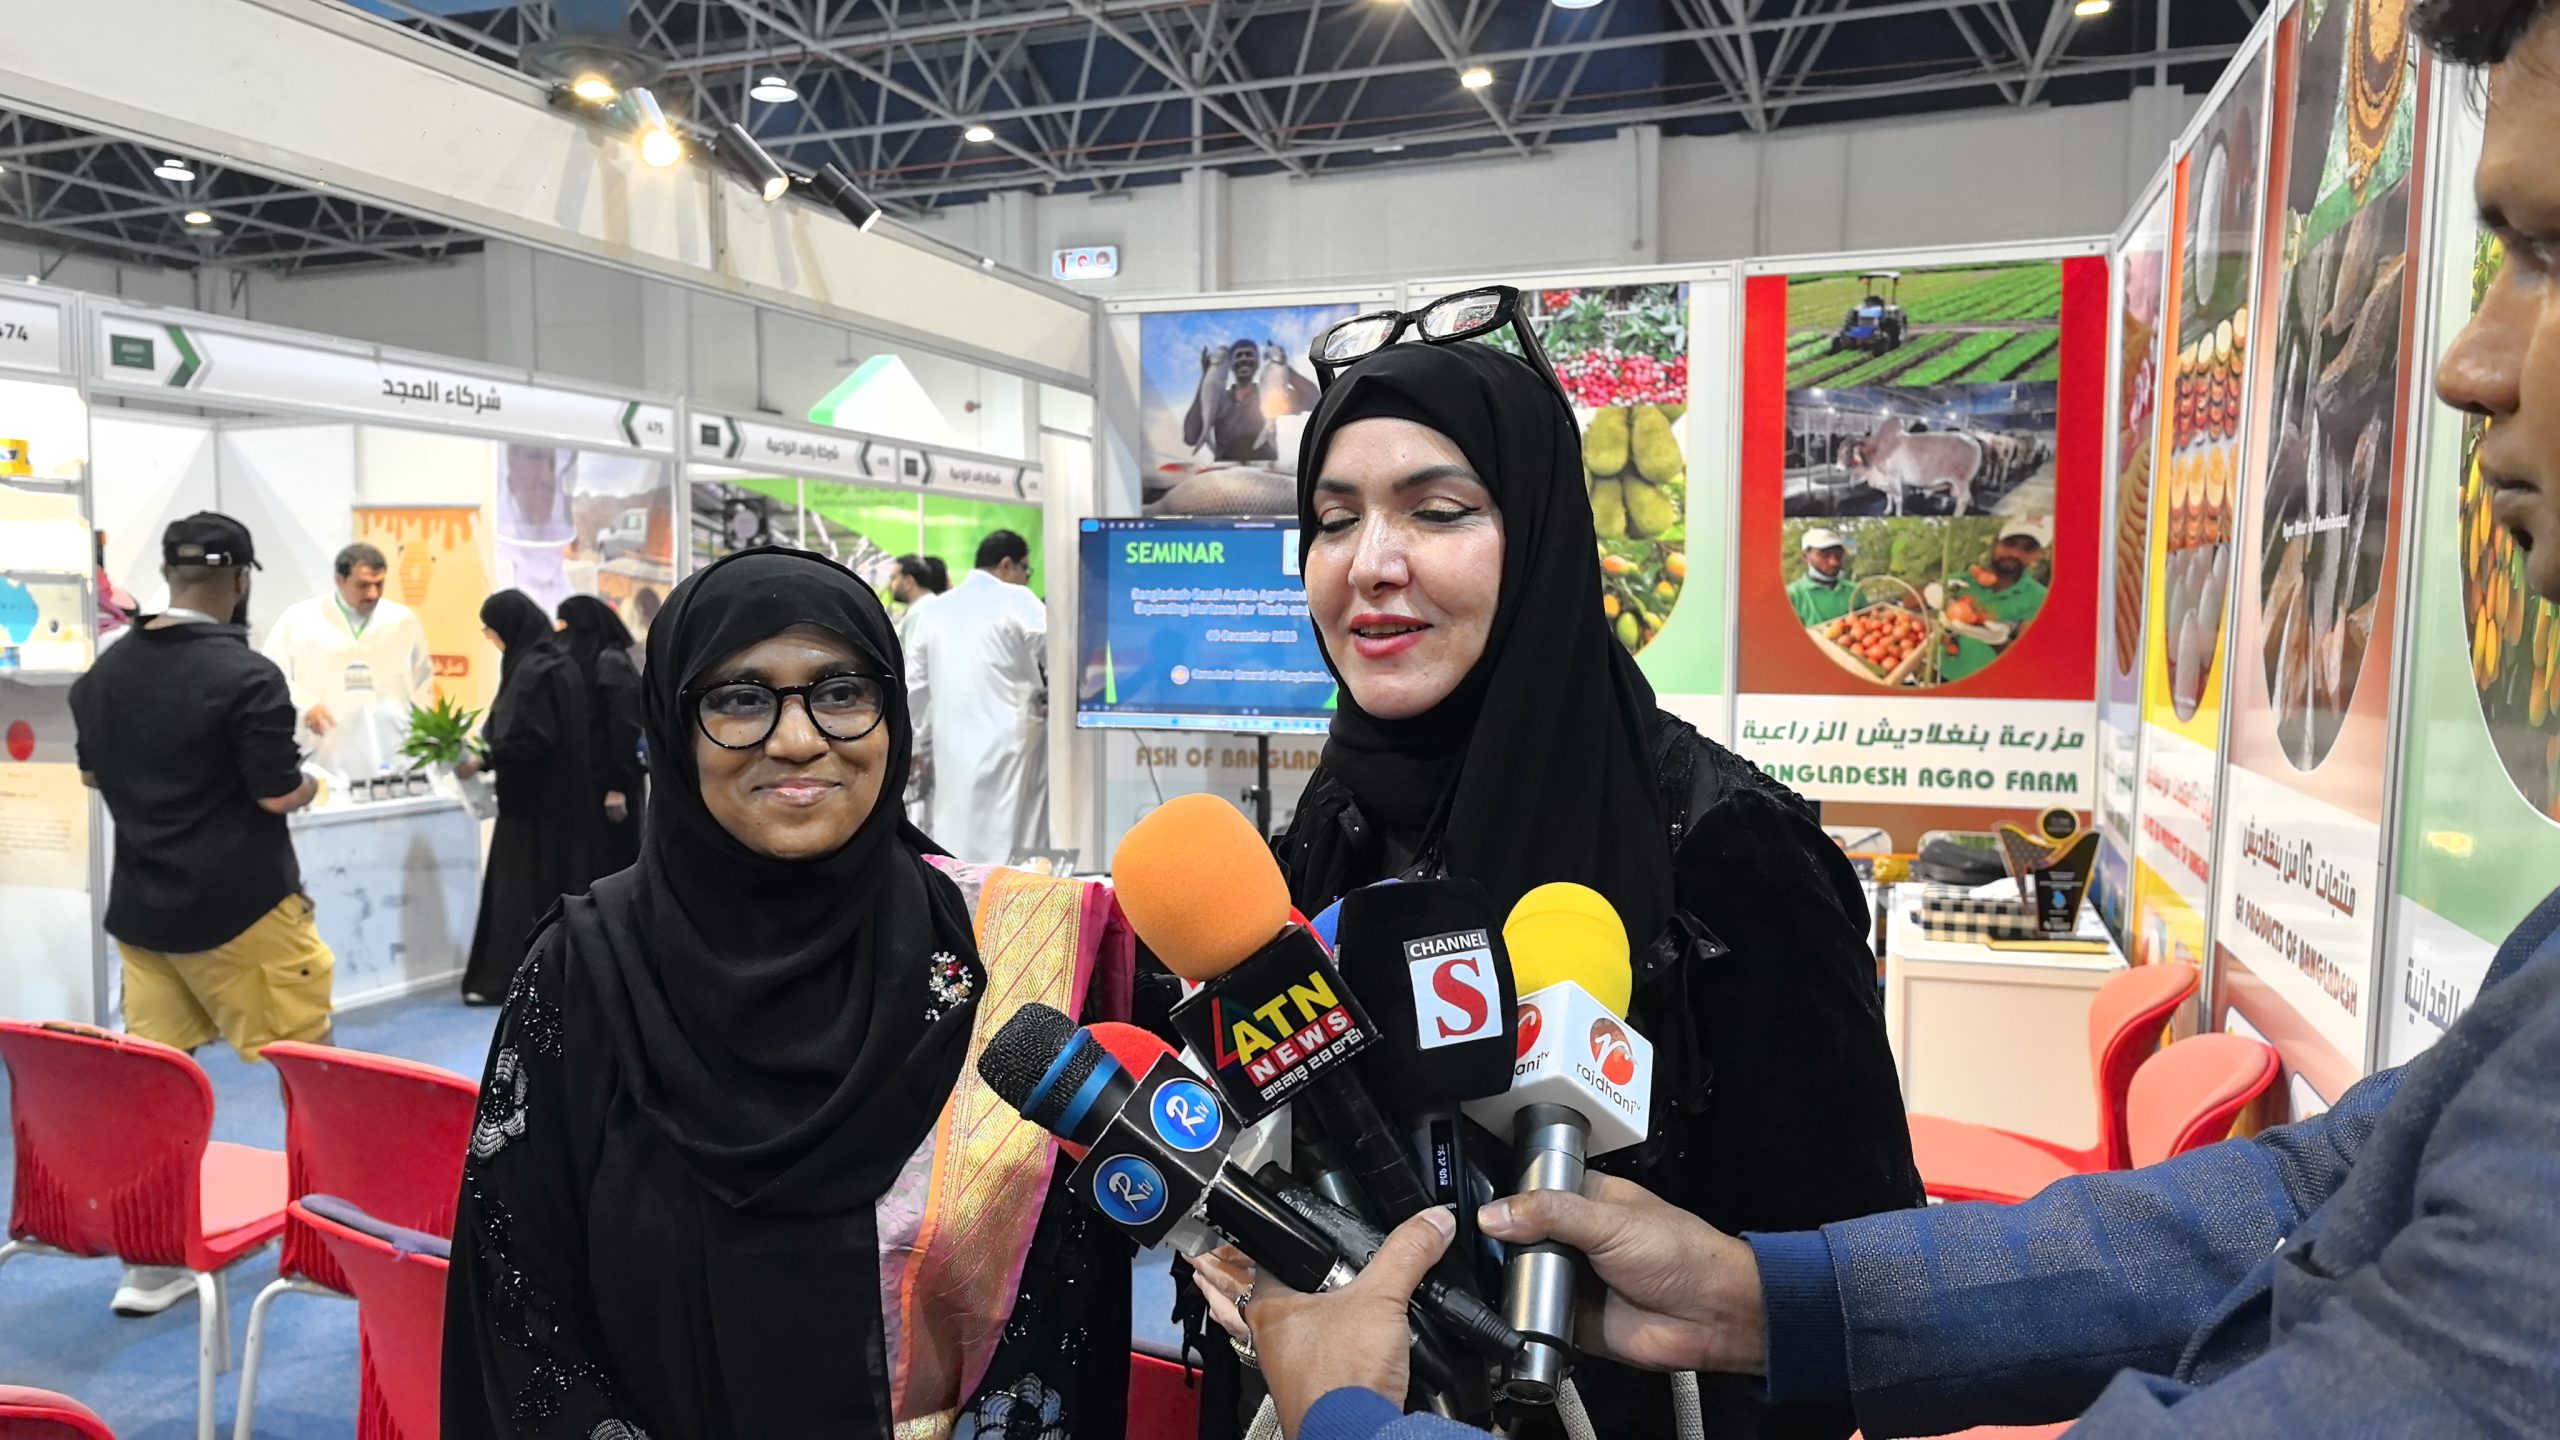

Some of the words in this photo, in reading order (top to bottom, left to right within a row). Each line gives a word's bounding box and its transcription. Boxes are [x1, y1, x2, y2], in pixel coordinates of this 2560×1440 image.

[0, 323, 28, 342] 74
[381, 378, 439, 404] المجد
[445, 386, 502, 414] شركاء
[1126, 541, 1225, 563] SEMINAR
[1742, 719, 1848, 746] الزراعية
[1856, 716, 1990, 752] بنغلاديش
[1999, 724, 2085, 753] مزرعة
[1186, 746, 1213, 767] OF
[1762, 762, 1908, 787] ANGLADESH
[1917, 766, 1996, 790] AGRO
[2006, 770, 2079, 794] FARM
[2314, 857, 2357, 919] منتجات
[1409, 932, 1487, 958] CHANNEL
[2235, 892, 2244, 924] GI
[2244, 899, 2285, 955] PRODUCTS
[2286, 928, 2298, 965] OF
[2299, 937, 2358, 1018] BANGLADESH
[1432, 956, 1489, 1039] S
[1232, 970, 1340, 1066] ATN
[1251, 1010, 1349, 1083] NEWS
[1260, 1063, 1309, 1102] বাংলার
